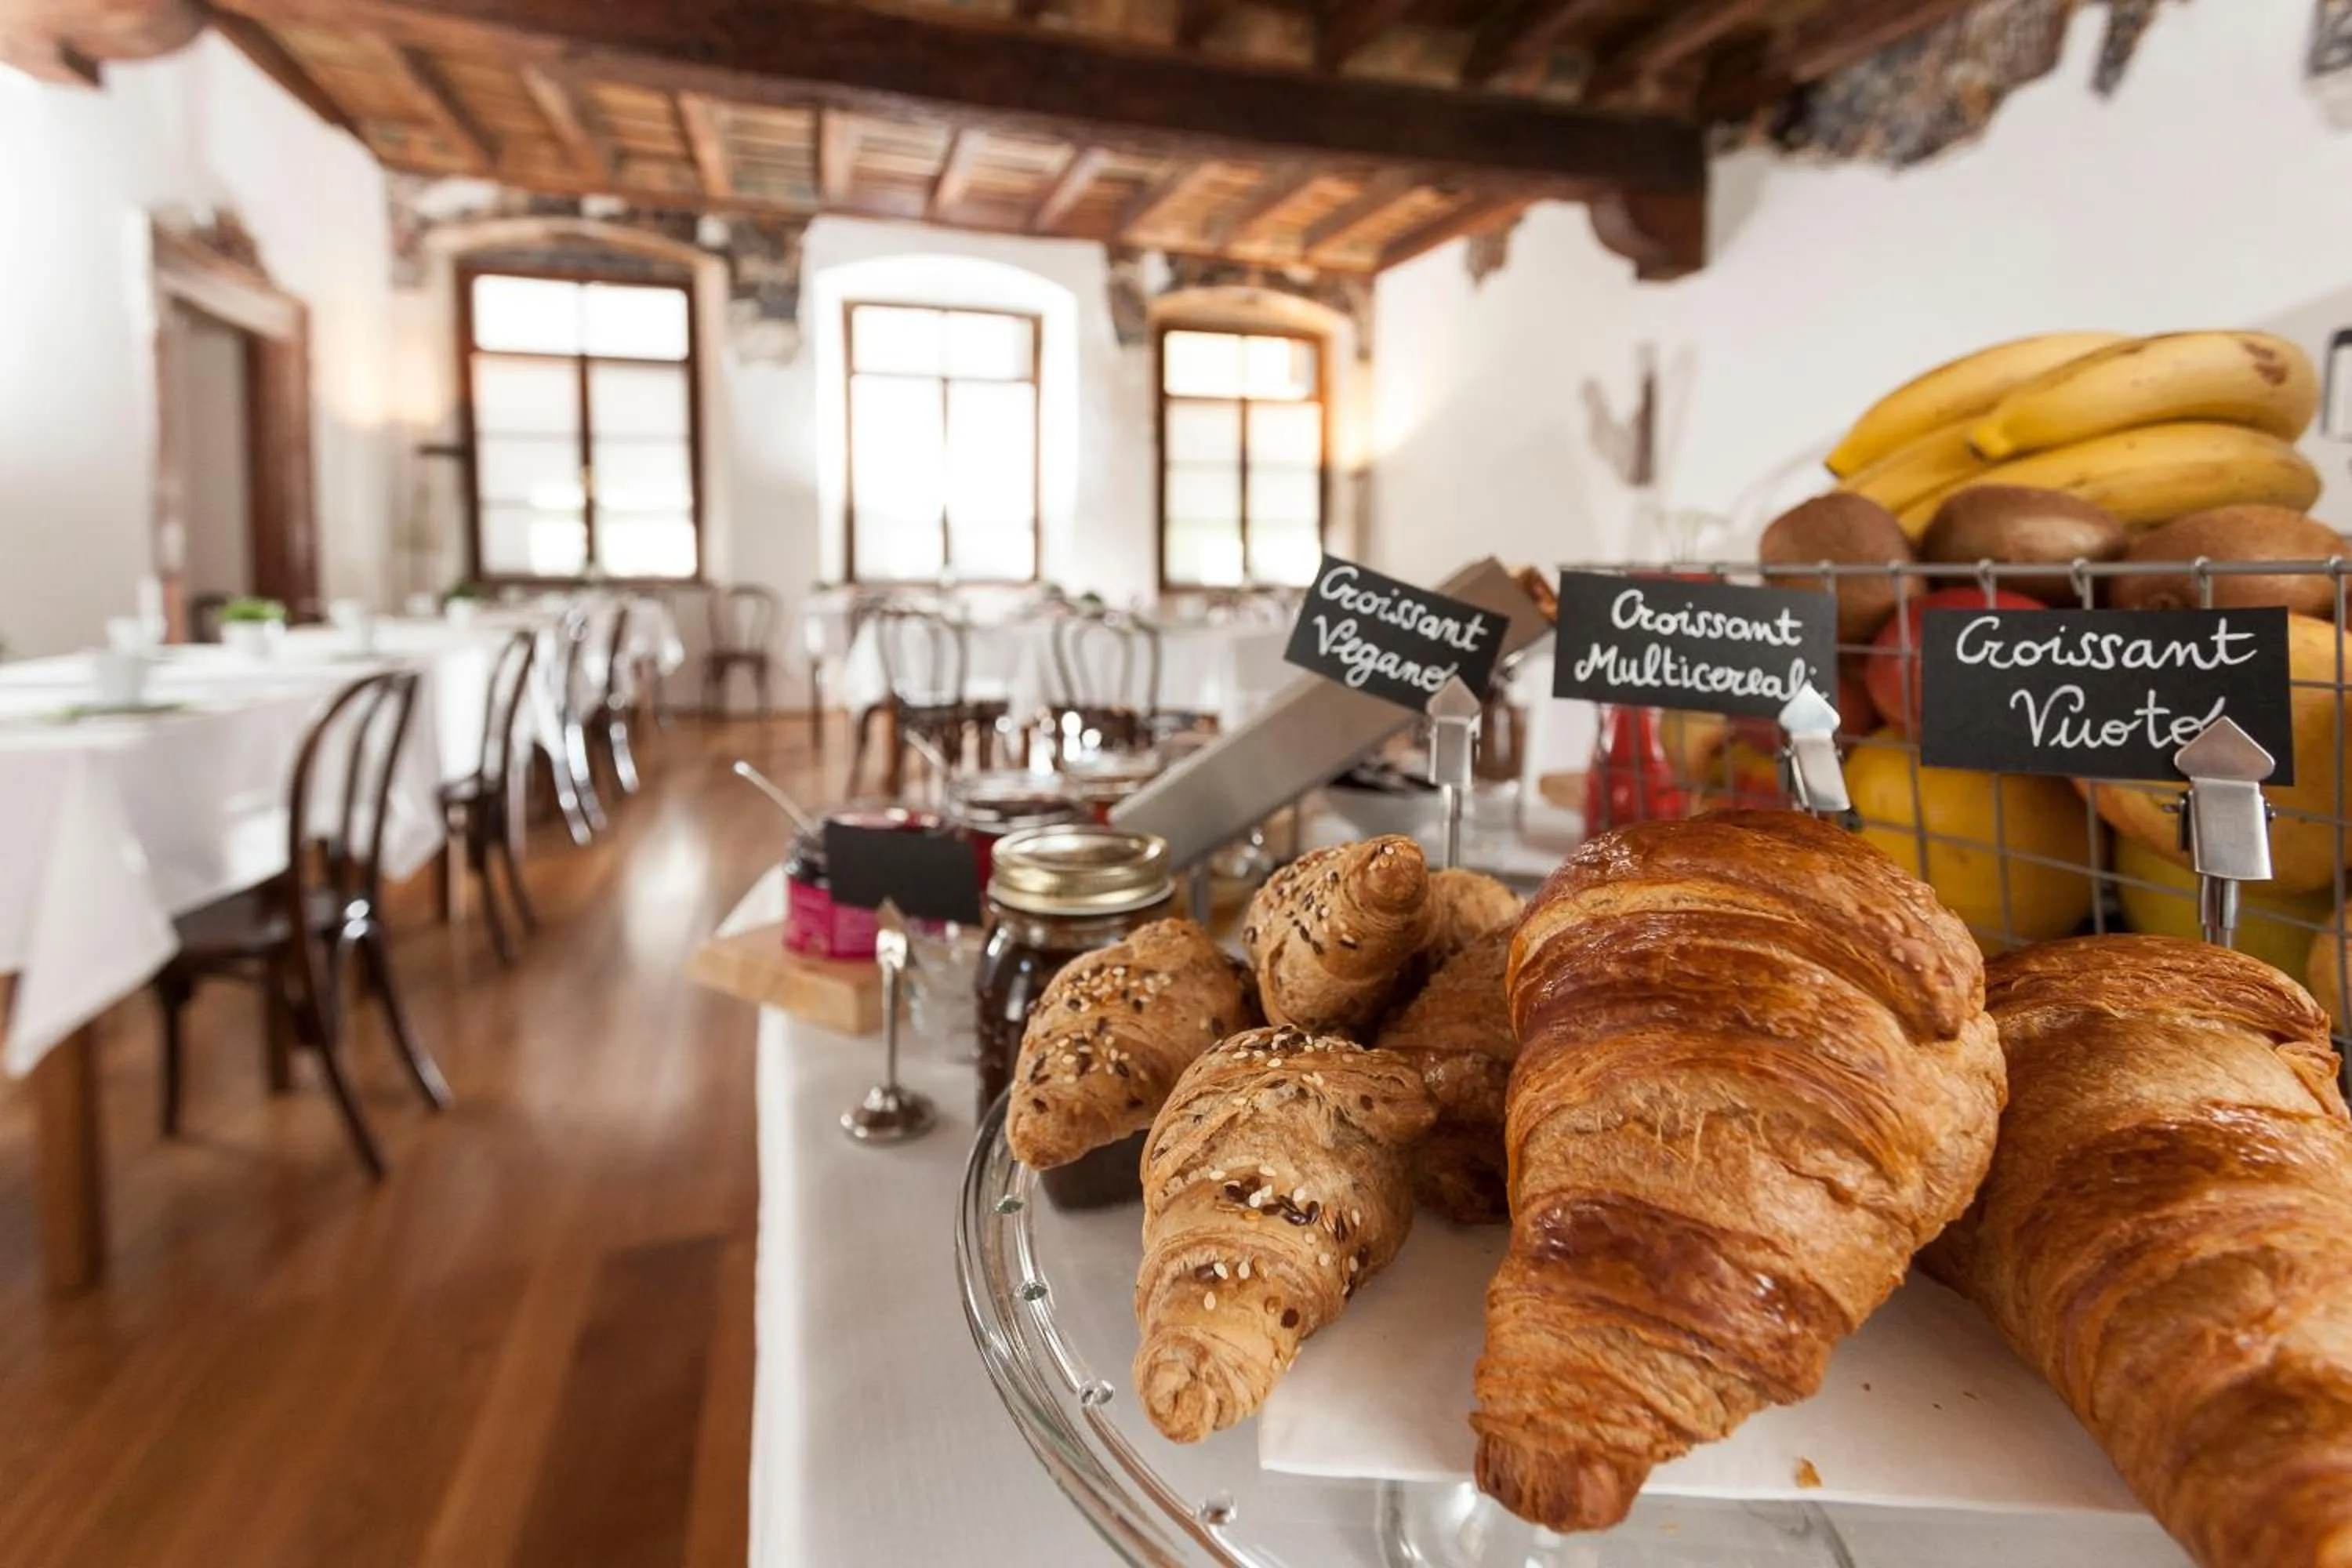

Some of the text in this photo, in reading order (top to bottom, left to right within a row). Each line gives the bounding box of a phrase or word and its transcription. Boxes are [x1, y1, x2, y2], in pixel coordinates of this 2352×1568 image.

[1319, 565, 1488, 652] Croissant
[1611, 589, 1802, 645] Croissant
[1312, 615, 1458, 692] Vegano
[1956, 615, 2258, 670] Croissant
[2009, 684, 2226, 749] Vuoto
